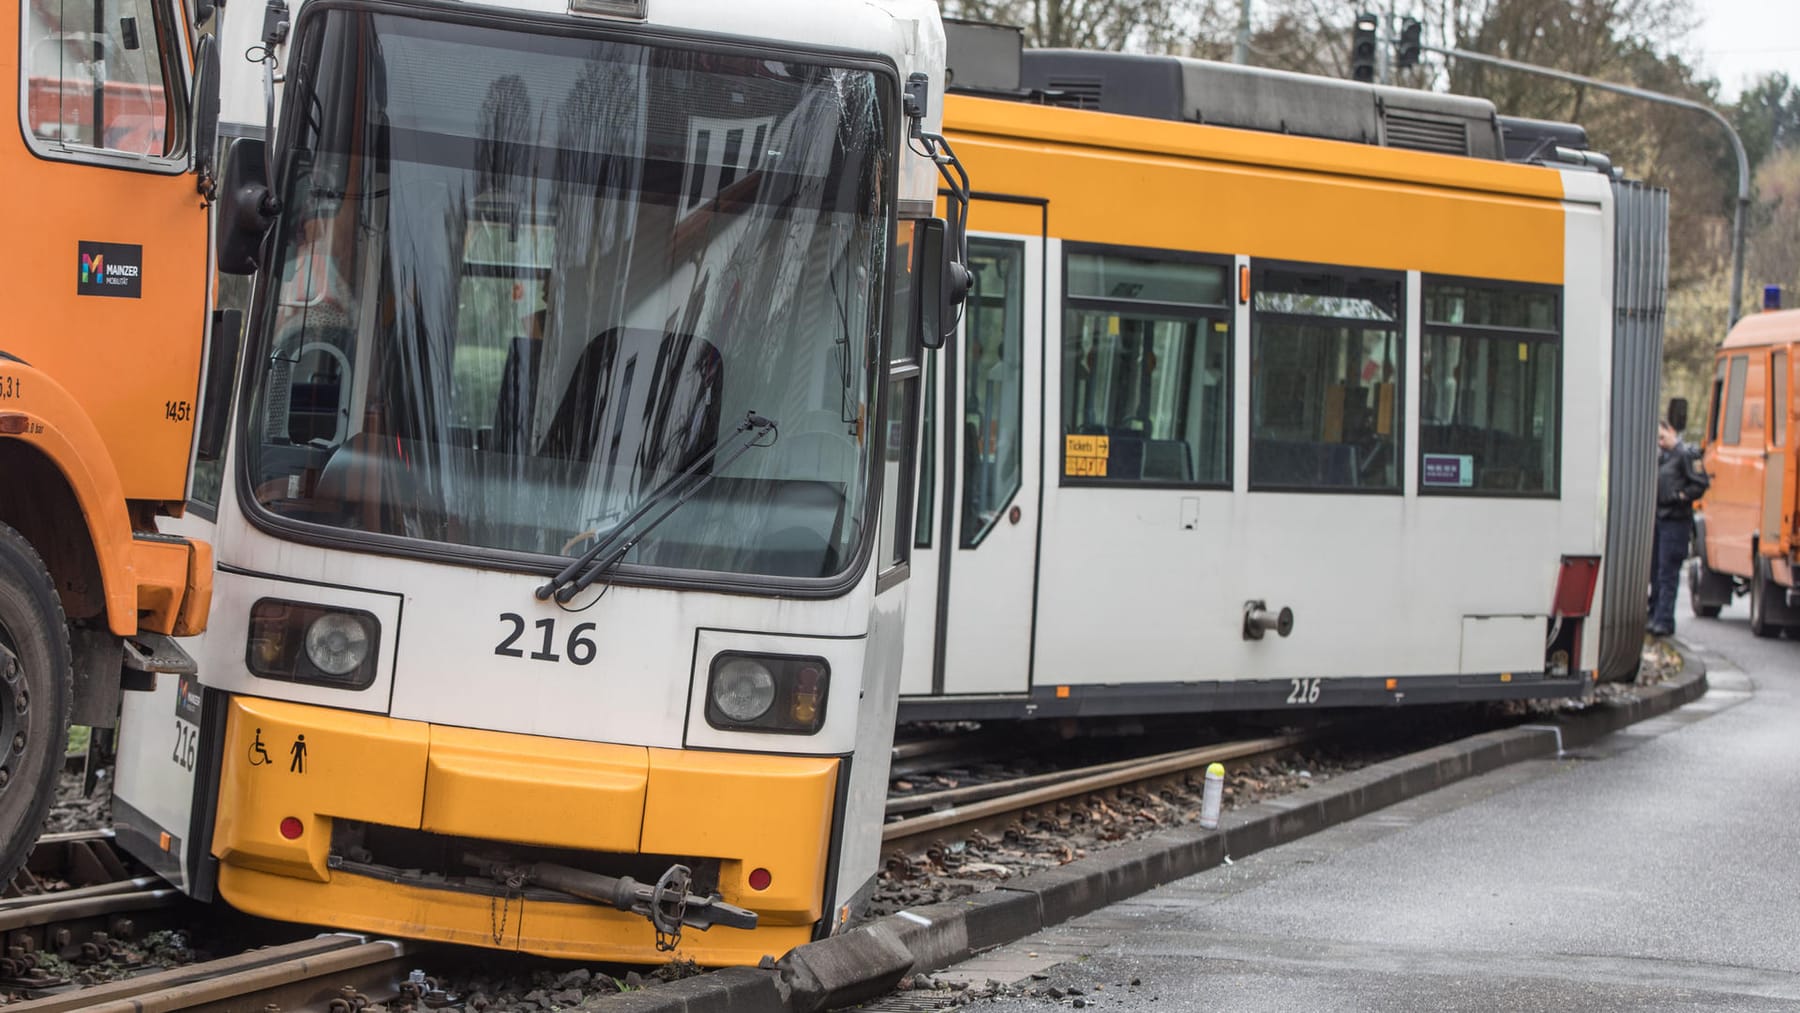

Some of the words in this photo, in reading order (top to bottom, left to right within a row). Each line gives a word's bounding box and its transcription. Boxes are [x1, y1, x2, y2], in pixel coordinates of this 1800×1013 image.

[106, 264, 138, 277] MAINZER
[1069, 439, 1093, 452] Tickets
[494, 612, 597, 666] 216
[1286, 678, 1321, 704] 216
[172, 719, 197, 773] 216
